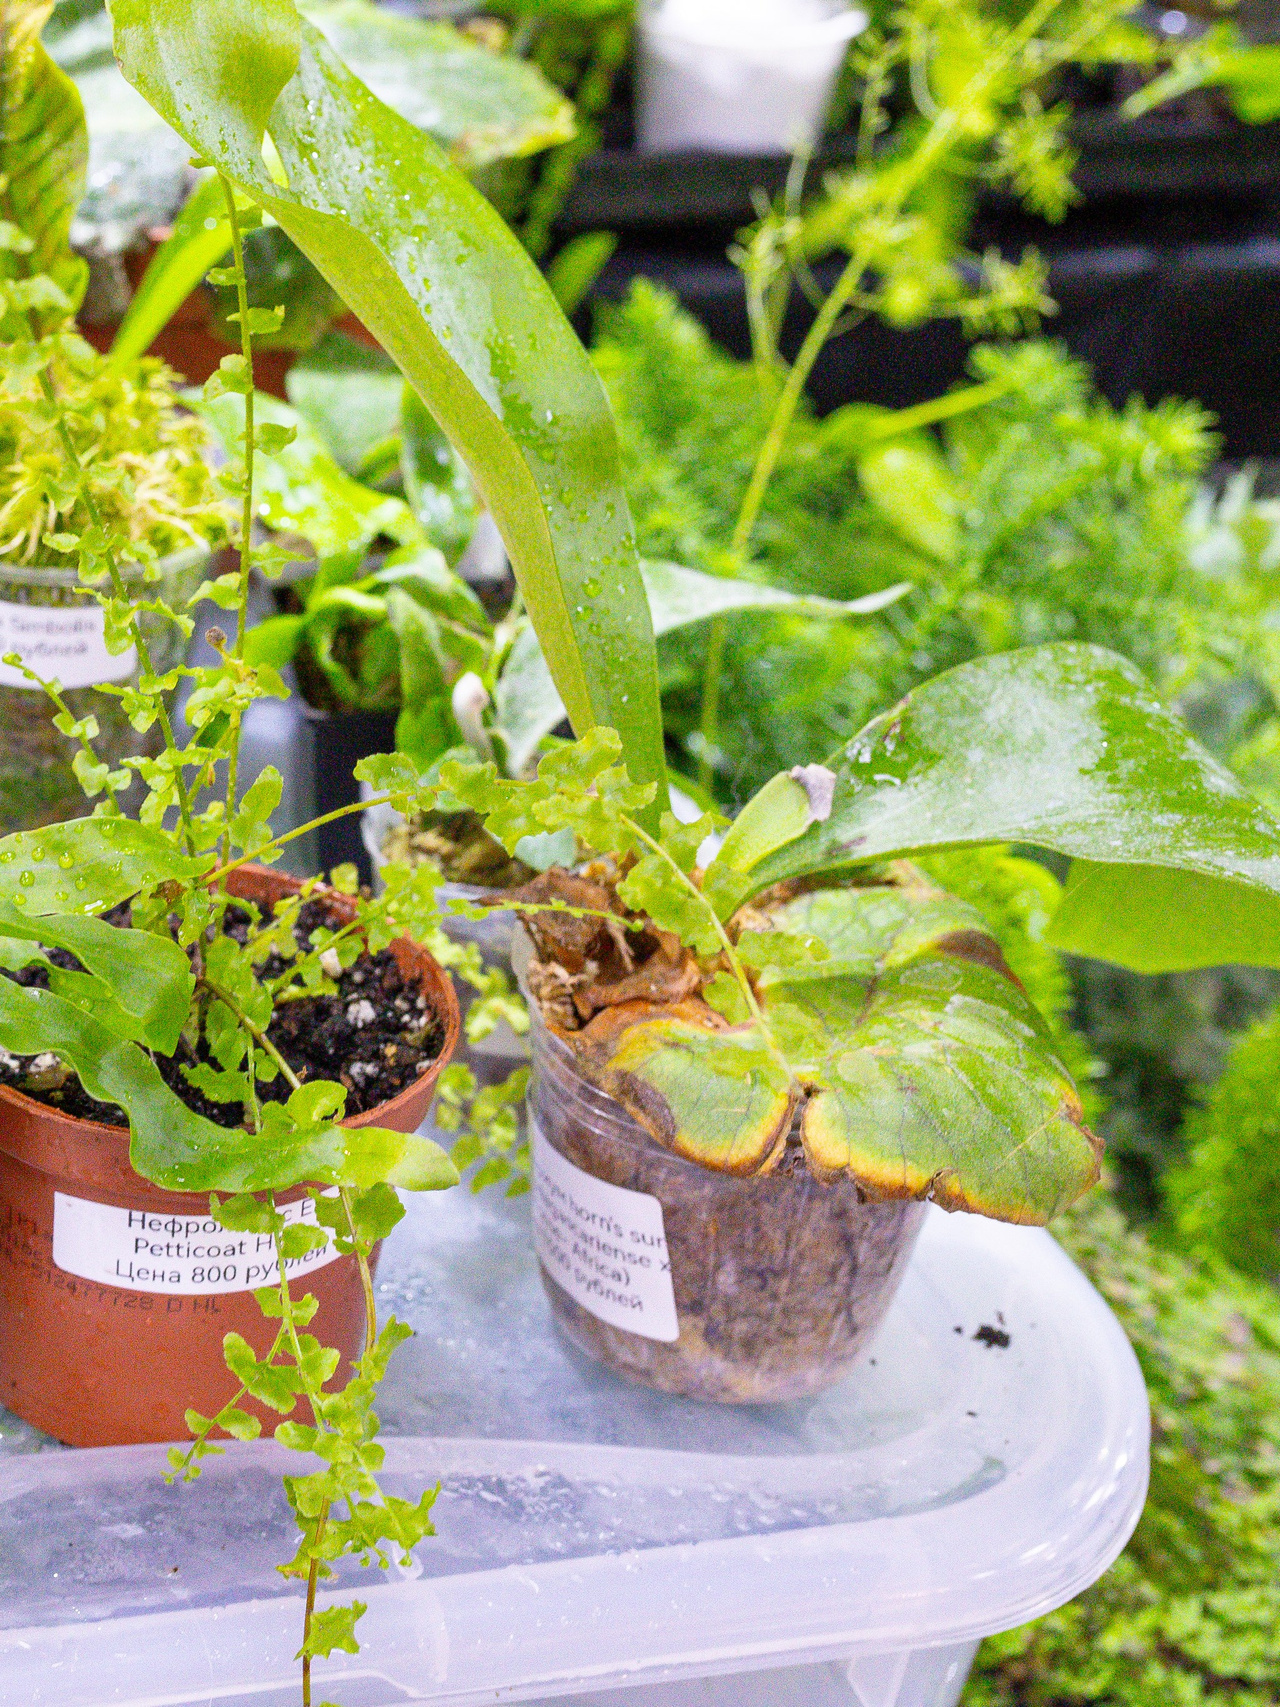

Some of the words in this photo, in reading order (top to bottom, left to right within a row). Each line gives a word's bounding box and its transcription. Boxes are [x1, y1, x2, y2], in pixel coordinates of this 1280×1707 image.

[133, 1236, 247, 1259] Petticoat
[115, 1258, 182, 1285] Цена
[190, 1264, 237, 1284] 800
